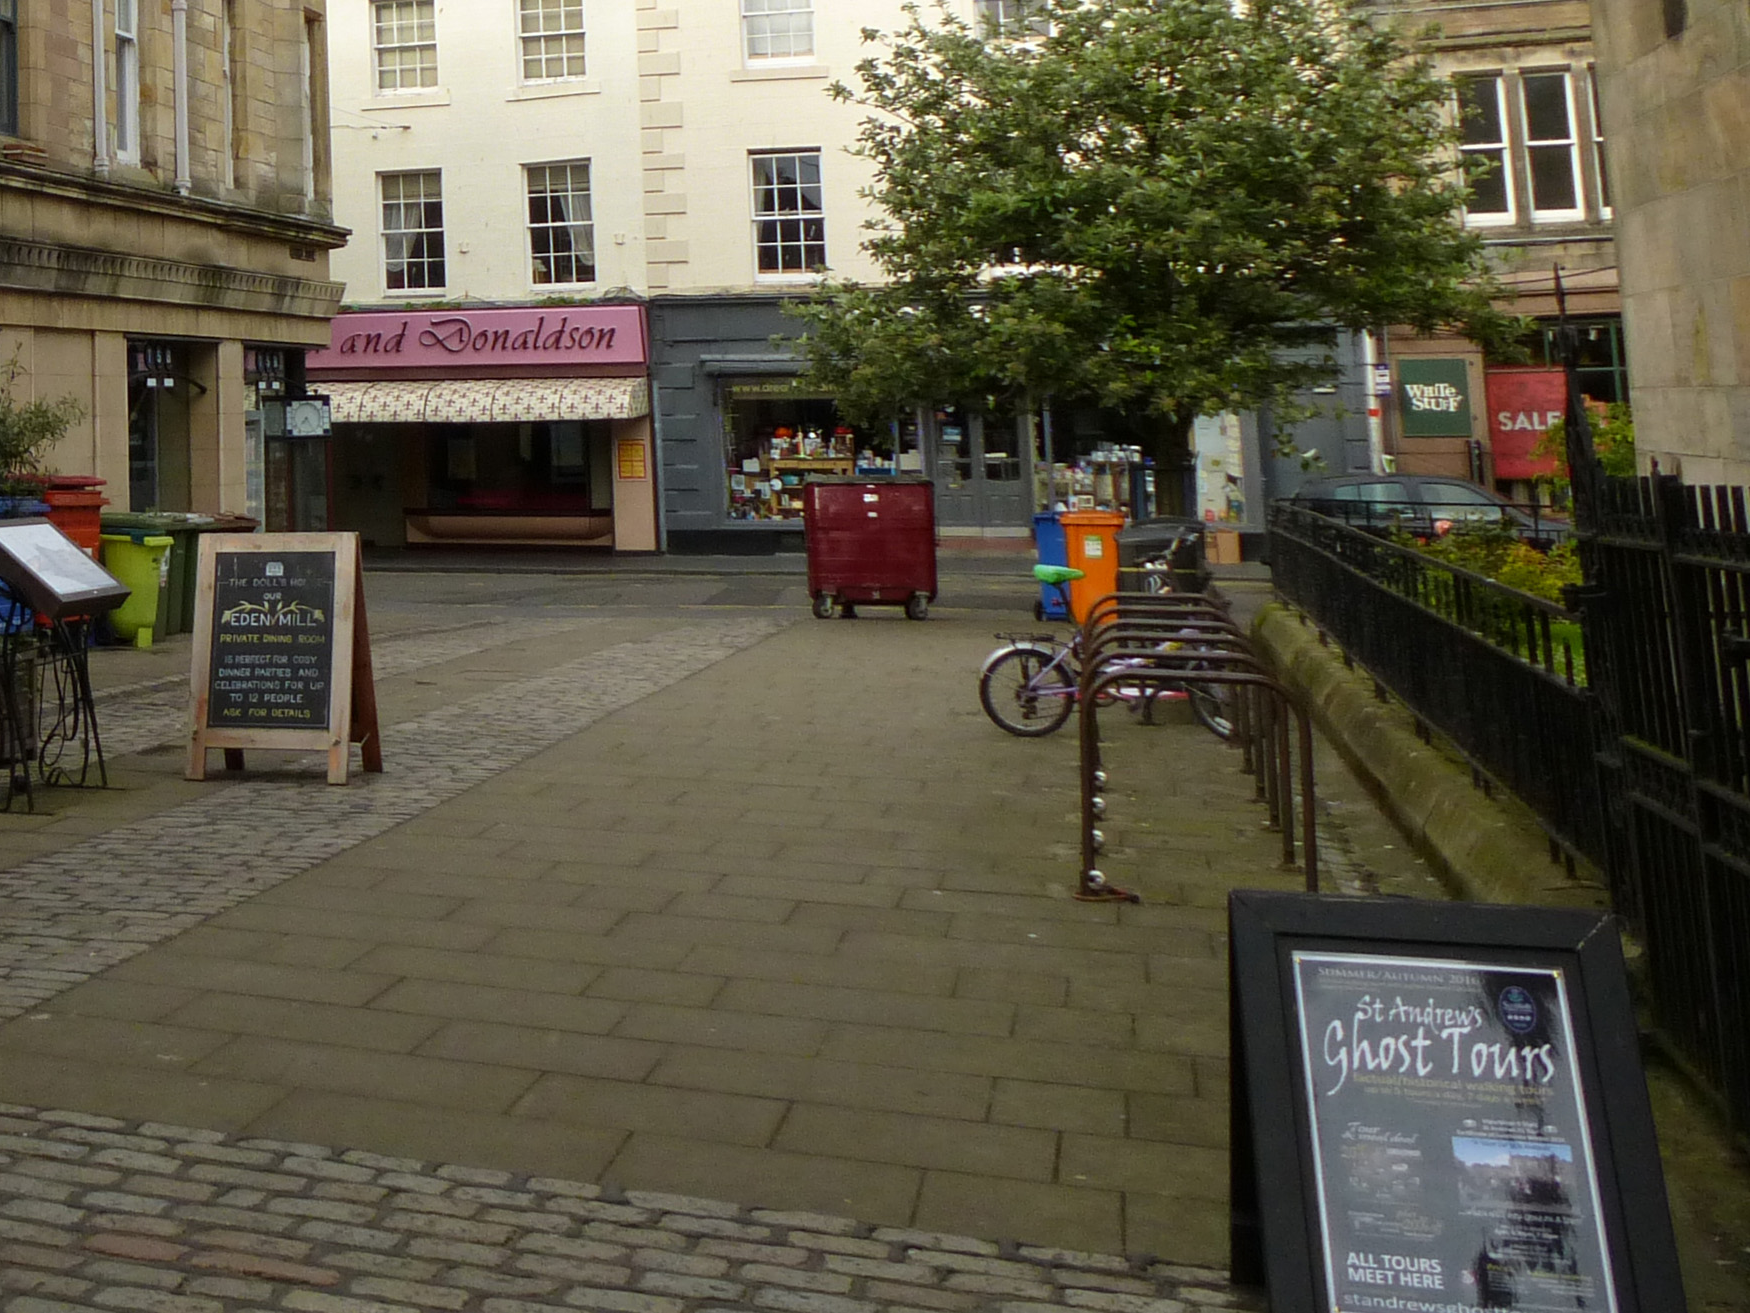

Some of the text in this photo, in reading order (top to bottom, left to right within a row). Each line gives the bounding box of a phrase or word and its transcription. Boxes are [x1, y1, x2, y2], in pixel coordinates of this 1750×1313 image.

[340, 321, 409, 355] and
[418, 315, 618, 353] Donaldson
[229, 578, 248, 587] THE
[263, 592, 282, 600] OUR
[230, 613, 317, 626] EDEN MILL
[219, 633, 326, 644] PRIVATE DINING ROOM
[224, 654, 318, 664] IS PERFECT FOR COSY
[218, 668, 319, 677] DINNER PARTIES AND
[214, 680, 325, 690] CELEBRATIONS FOR UP
[229, 693, 304, 703] TO 12 PEOPLE
[223, 708, 311, 719] ASK FOR DETAILS
[1356, 994, 1484, 1034] St Andrews
[1323, 1013, 1556, 1096] Ghost Tours
[1346, 1251, 1442, 1273] ALL TOURS
[1347, 1267, 1445, 1290] MEET HERE
